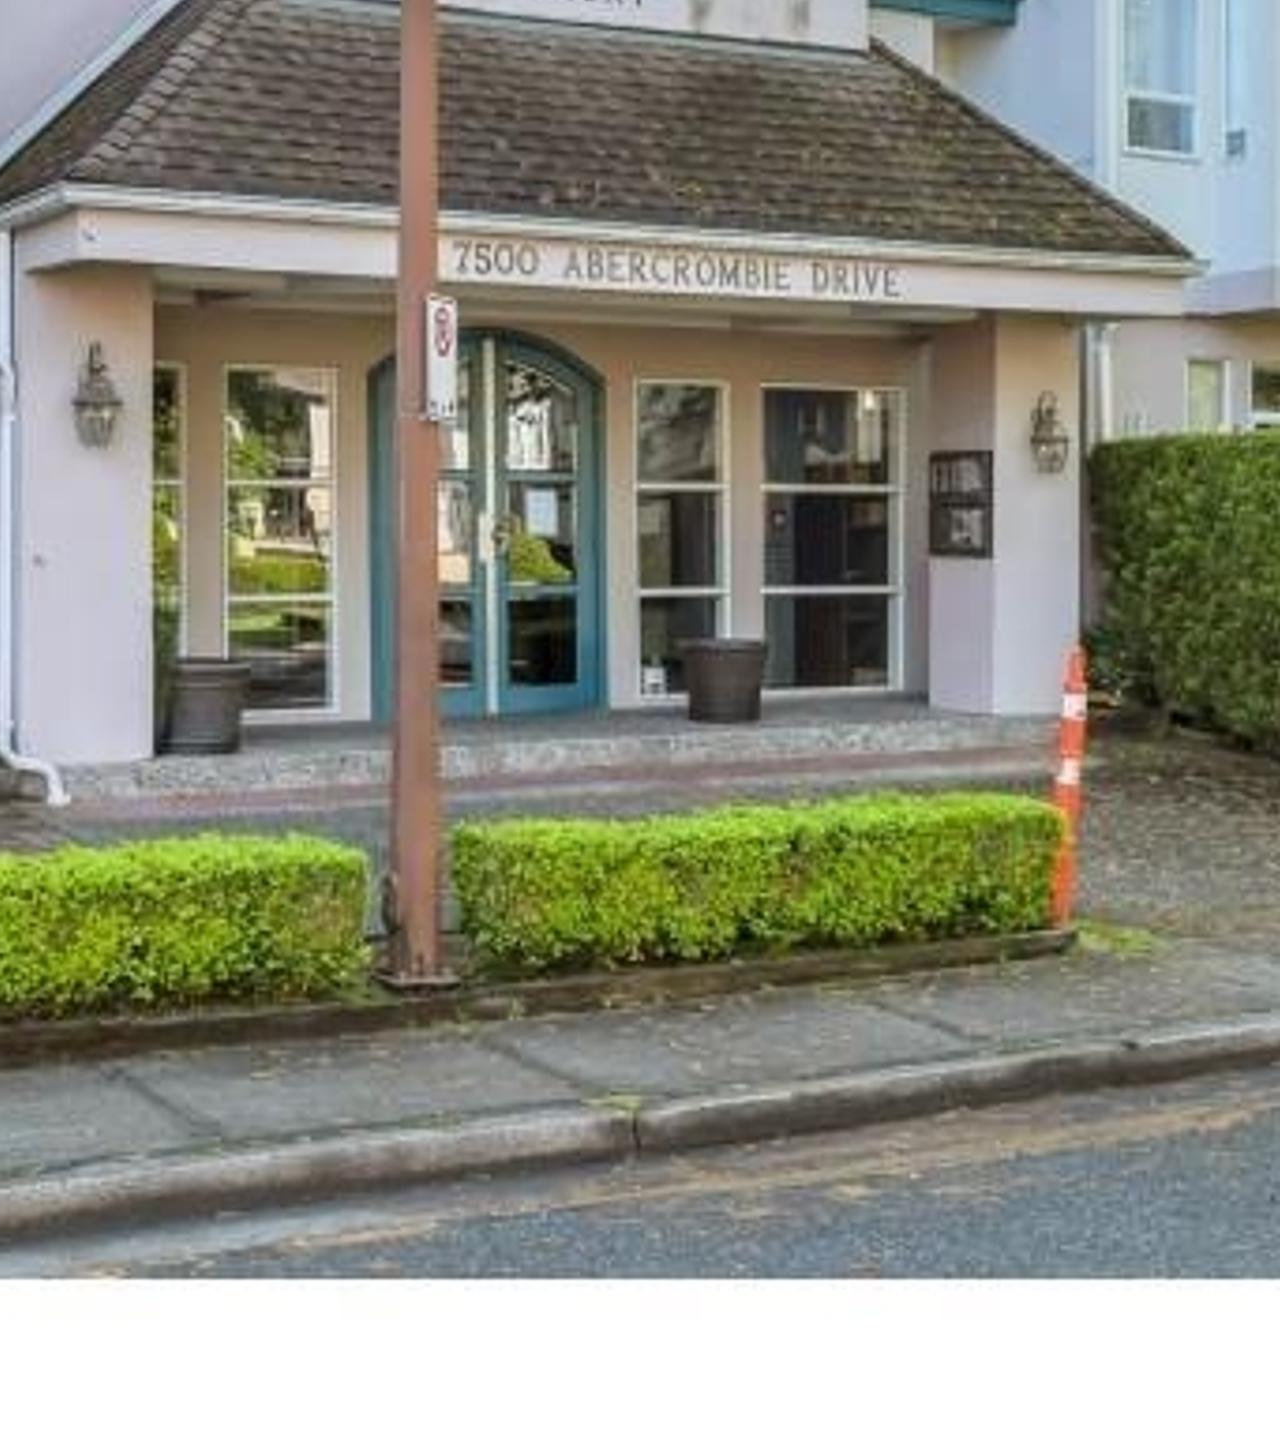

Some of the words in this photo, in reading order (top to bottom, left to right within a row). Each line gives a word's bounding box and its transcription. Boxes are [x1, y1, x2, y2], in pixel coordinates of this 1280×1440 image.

[452, 240, 540, 276] 7500
[564, 250, 791, 291] ABERCROMBIE
[811, 262, 901, 296] DRIVE
